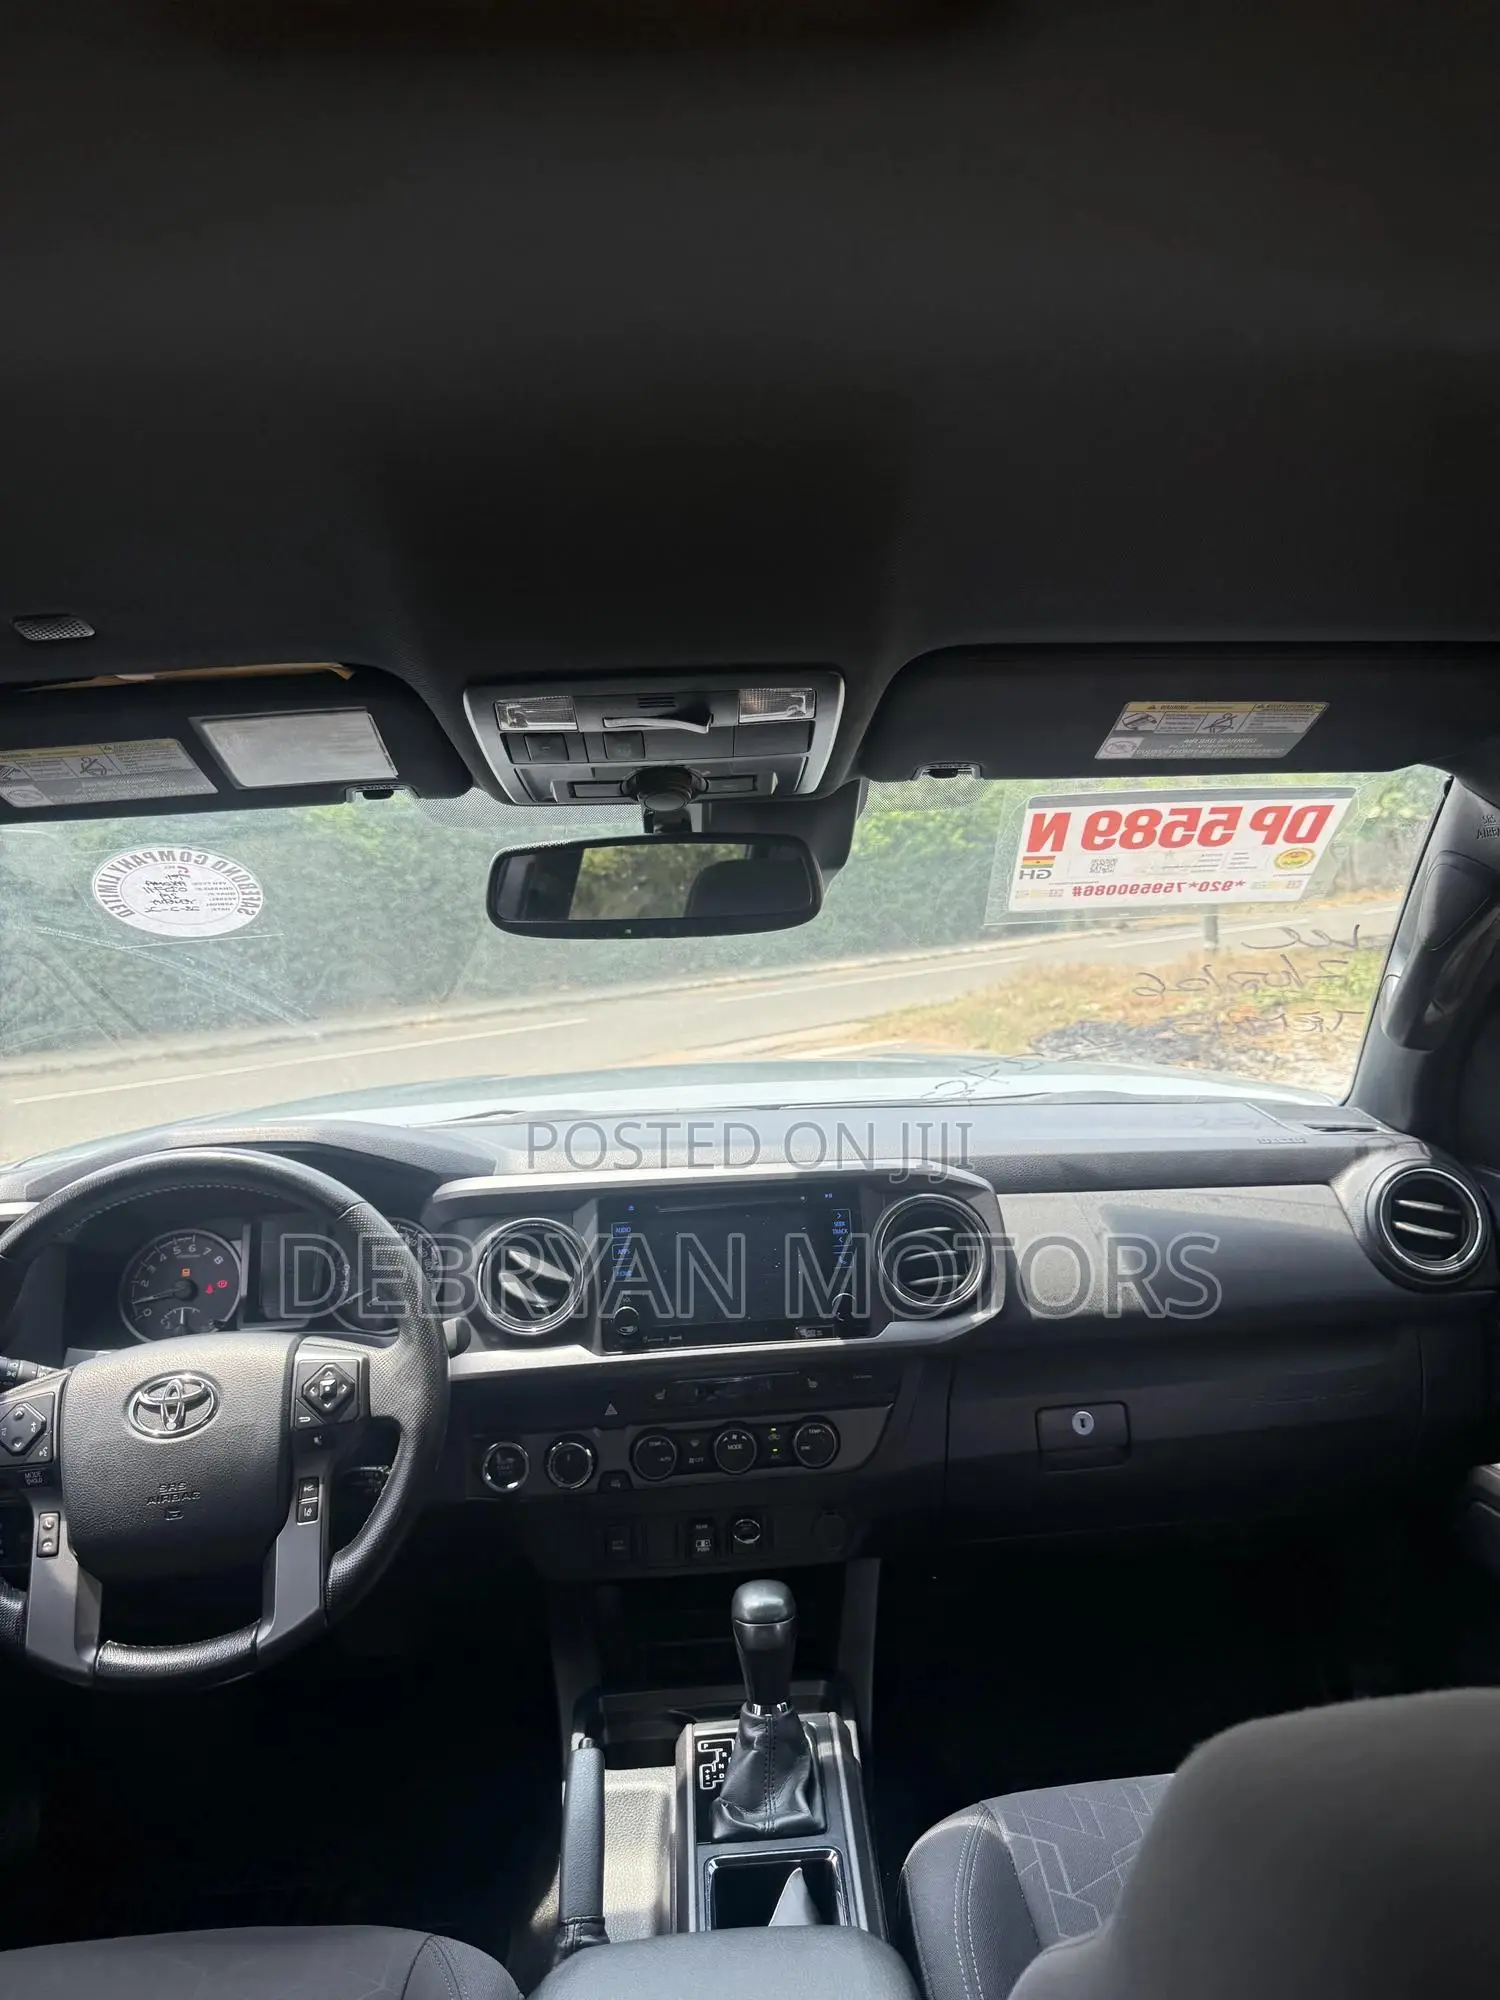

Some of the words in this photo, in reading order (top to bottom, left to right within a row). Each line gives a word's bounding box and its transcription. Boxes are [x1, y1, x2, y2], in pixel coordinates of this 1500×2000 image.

[173, 1246, 182, 1255] 5
[188, 1244, 196, 1252] 6
[159, 1482, 187, 1493] SRS
[145, 1490, 201, 1506] AIRBAG
